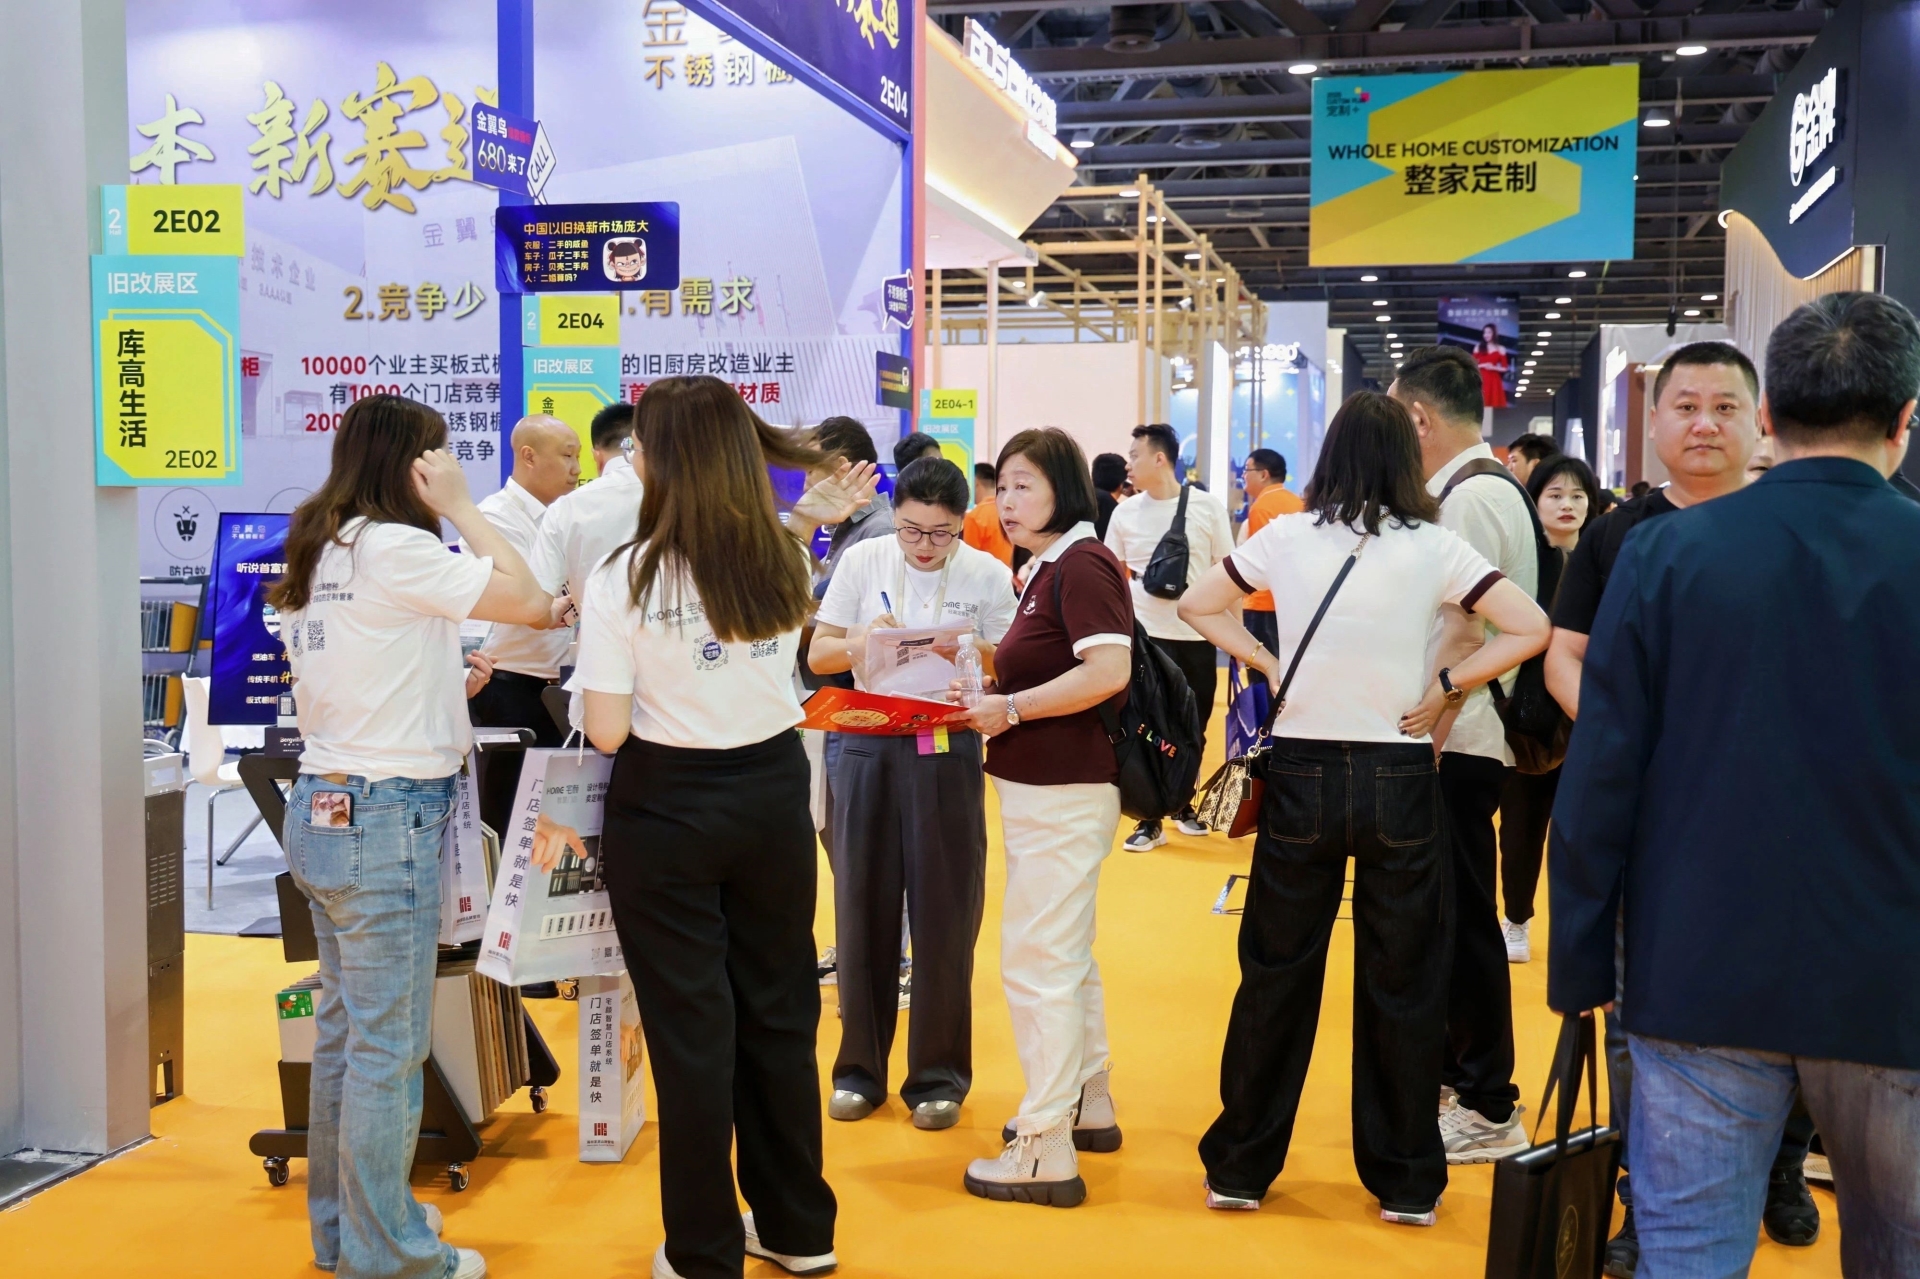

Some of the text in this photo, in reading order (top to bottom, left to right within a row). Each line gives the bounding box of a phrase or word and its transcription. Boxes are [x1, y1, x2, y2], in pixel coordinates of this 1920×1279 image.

[880, 75, 909, 118] 2E04
[476, 110, 508, 139] 金翼鸟
[1328, 136, 1619, 160] WHOLE HOME CUSTOMIZATION
[530, 144, 550, 184] CALL
[1404, 161, 1537, 195] 整家定制
[108, 208, 221, 233] 2 2E02
[422, 215, 497, 248] 金翼
[523, 220, 650, 236] 中国以旧换新市场庞大
[107, 271, 199, 295] 旧改展区
[343, 281, 486, 320] 2.竞争少
[557, 312, 605, 329] 2E04
[533, 359, 594, 375] 旧改展区
[622, 353, 795, 375] 的旧厨房改造业主
[117, 328, 148, 448] 库高生活
[727, 382, 781, 404] 材质
[935, 400, 974, 409] 2E04-1
[165, 449, 218, 469] 2E02
[448, 440, 495, 461] 竞争
[1146, 730, 1177, 757] LOVE
[504, 778, 543, 908] 门店签单就是快
[589, 997, 602, 1103] 门店签单就是快
